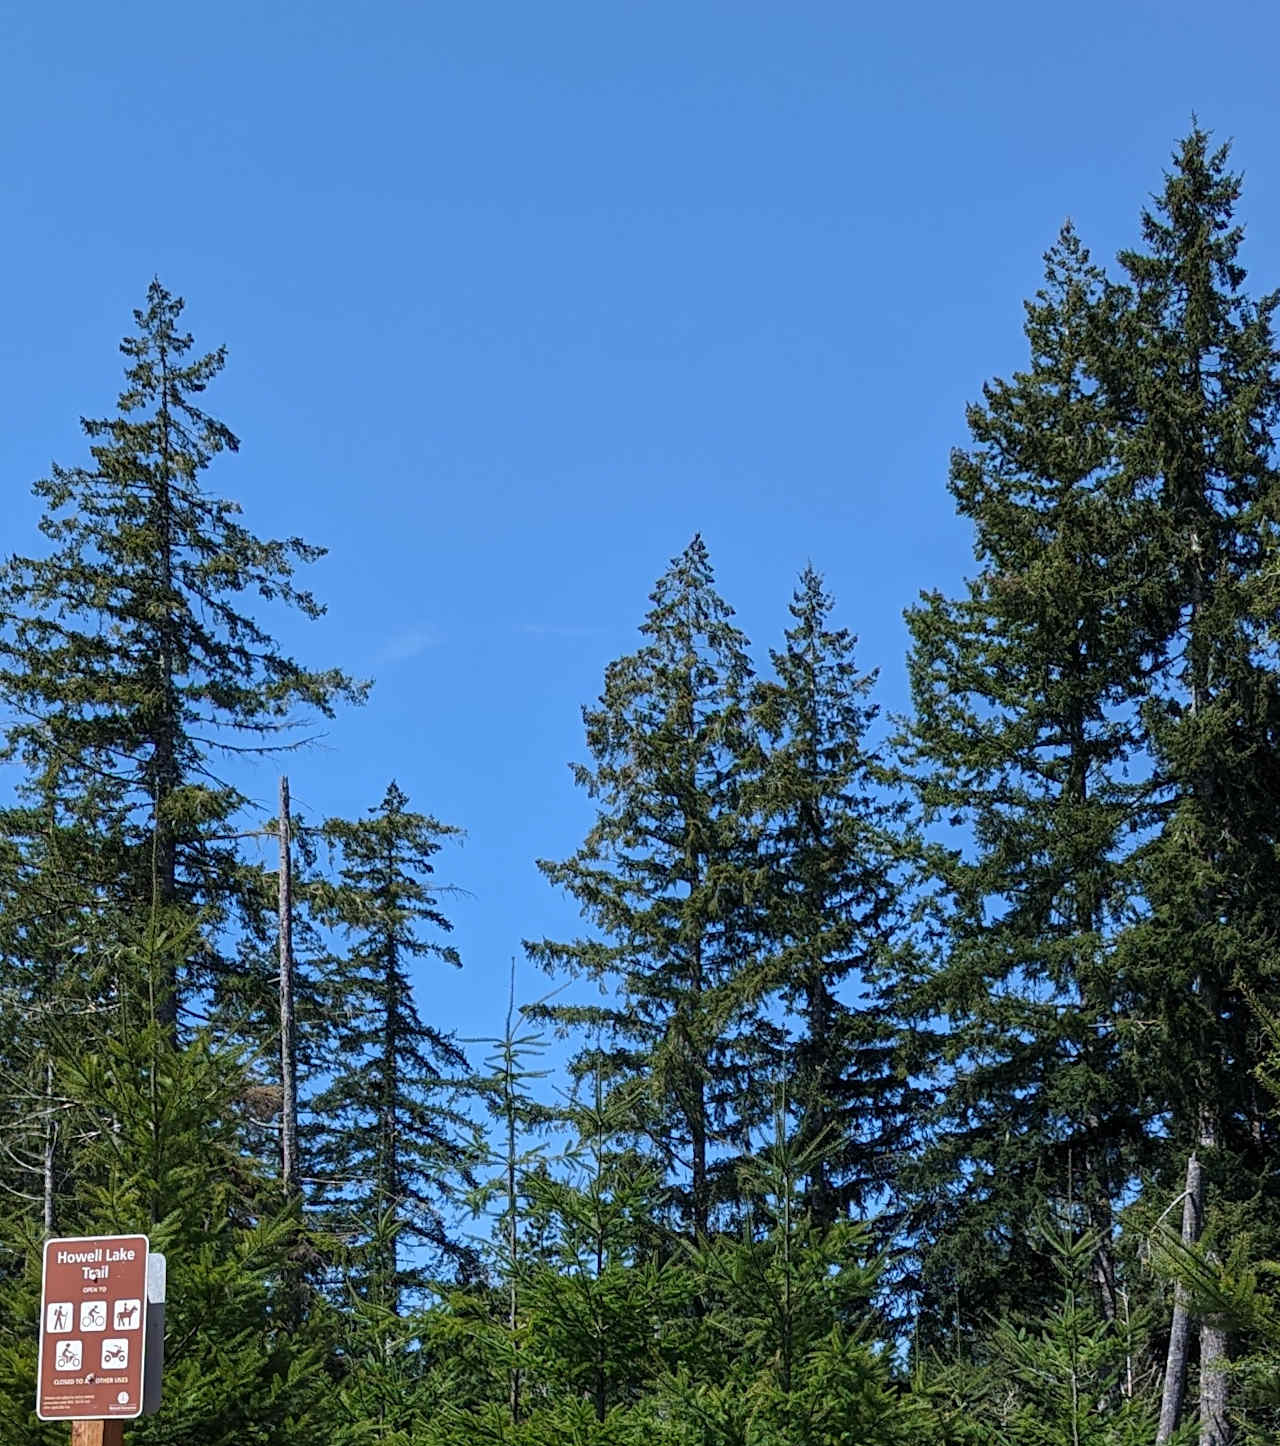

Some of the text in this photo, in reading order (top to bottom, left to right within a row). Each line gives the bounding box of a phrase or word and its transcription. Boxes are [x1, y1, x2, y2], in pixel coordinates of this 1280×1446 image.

[57, 1248, 135, 1264] Howell Lake
[76, 1377, 84, 1385] TO
